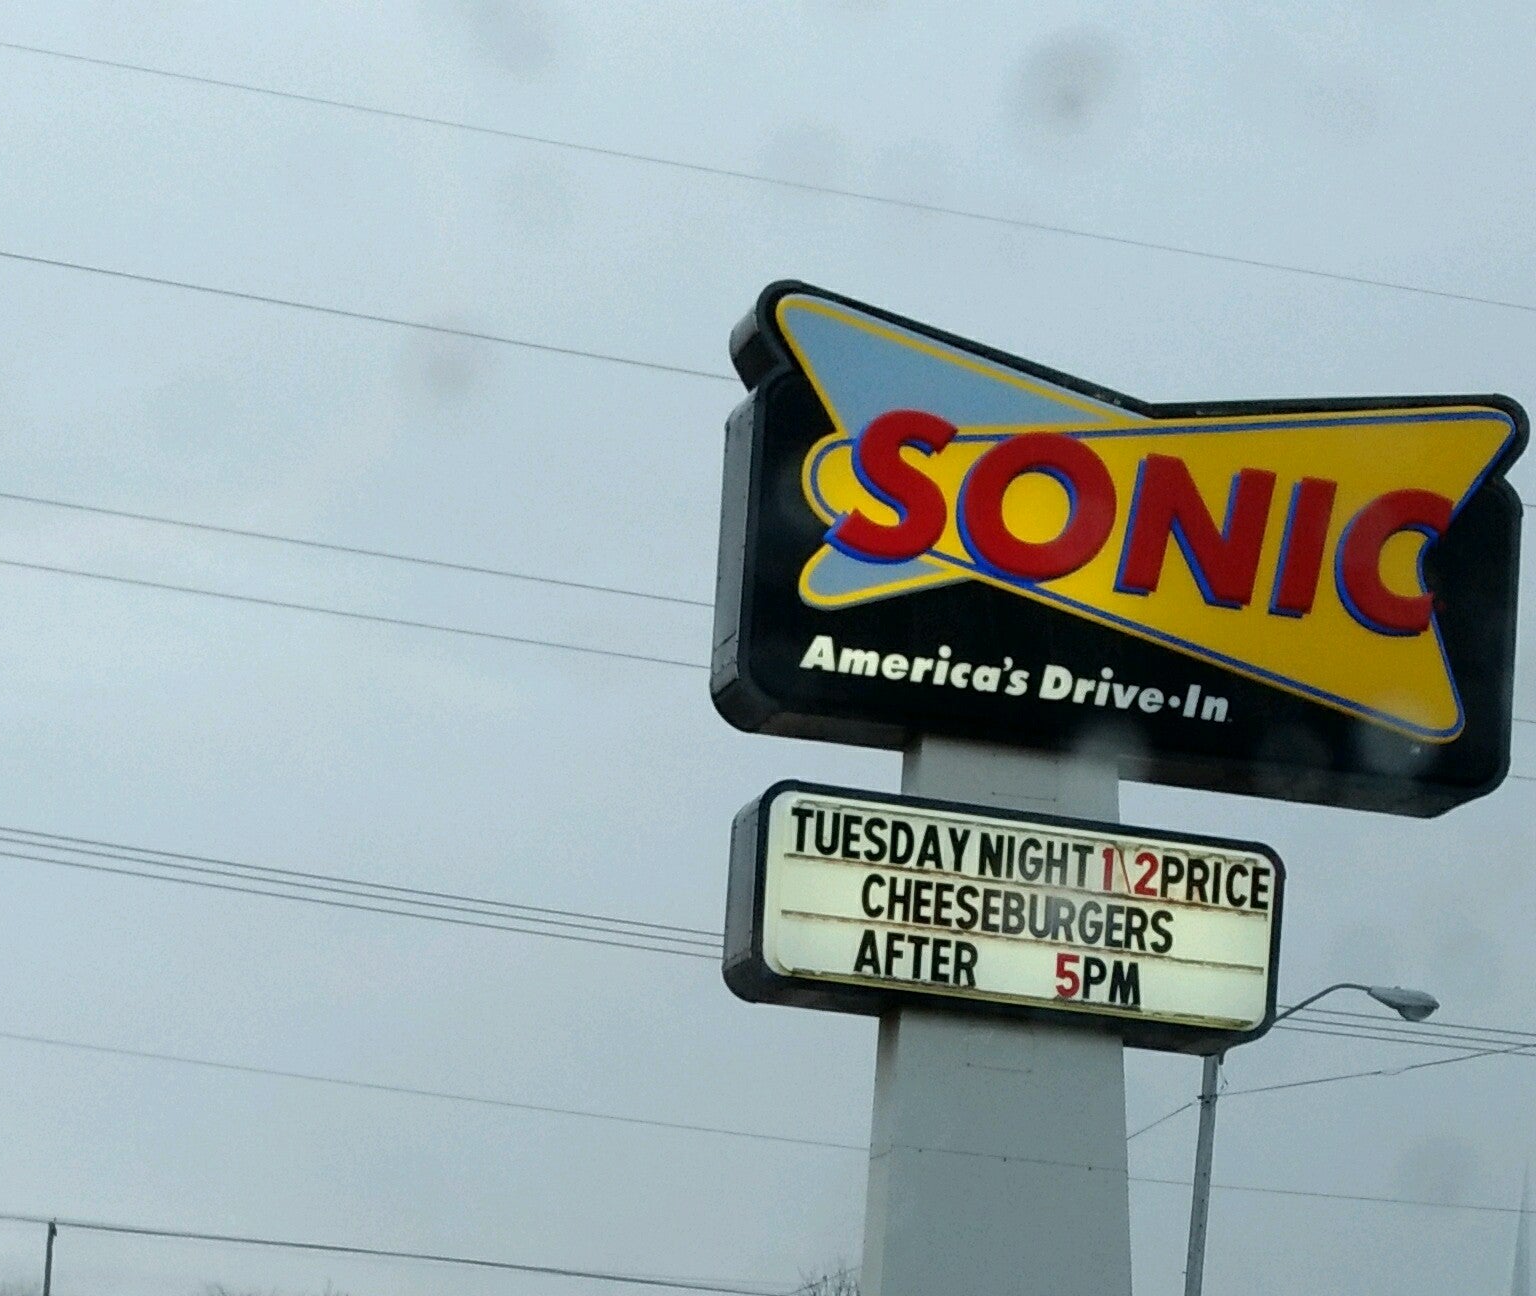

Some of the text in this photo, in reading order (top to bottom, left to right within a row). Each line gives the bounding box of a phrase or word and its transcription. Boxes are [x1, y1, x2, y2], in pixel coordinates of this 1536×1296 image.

[825, 409, 1455, 638] SONIC
[799, 634, 1031, 696] America's
[791, 806, 971, 873] TUESDAY
[978, 832, 1095, 887] NIGHT
[861, 873, 1175, 954] CHEESEBURGERS
[853, 929, 979, 988] AFTER
